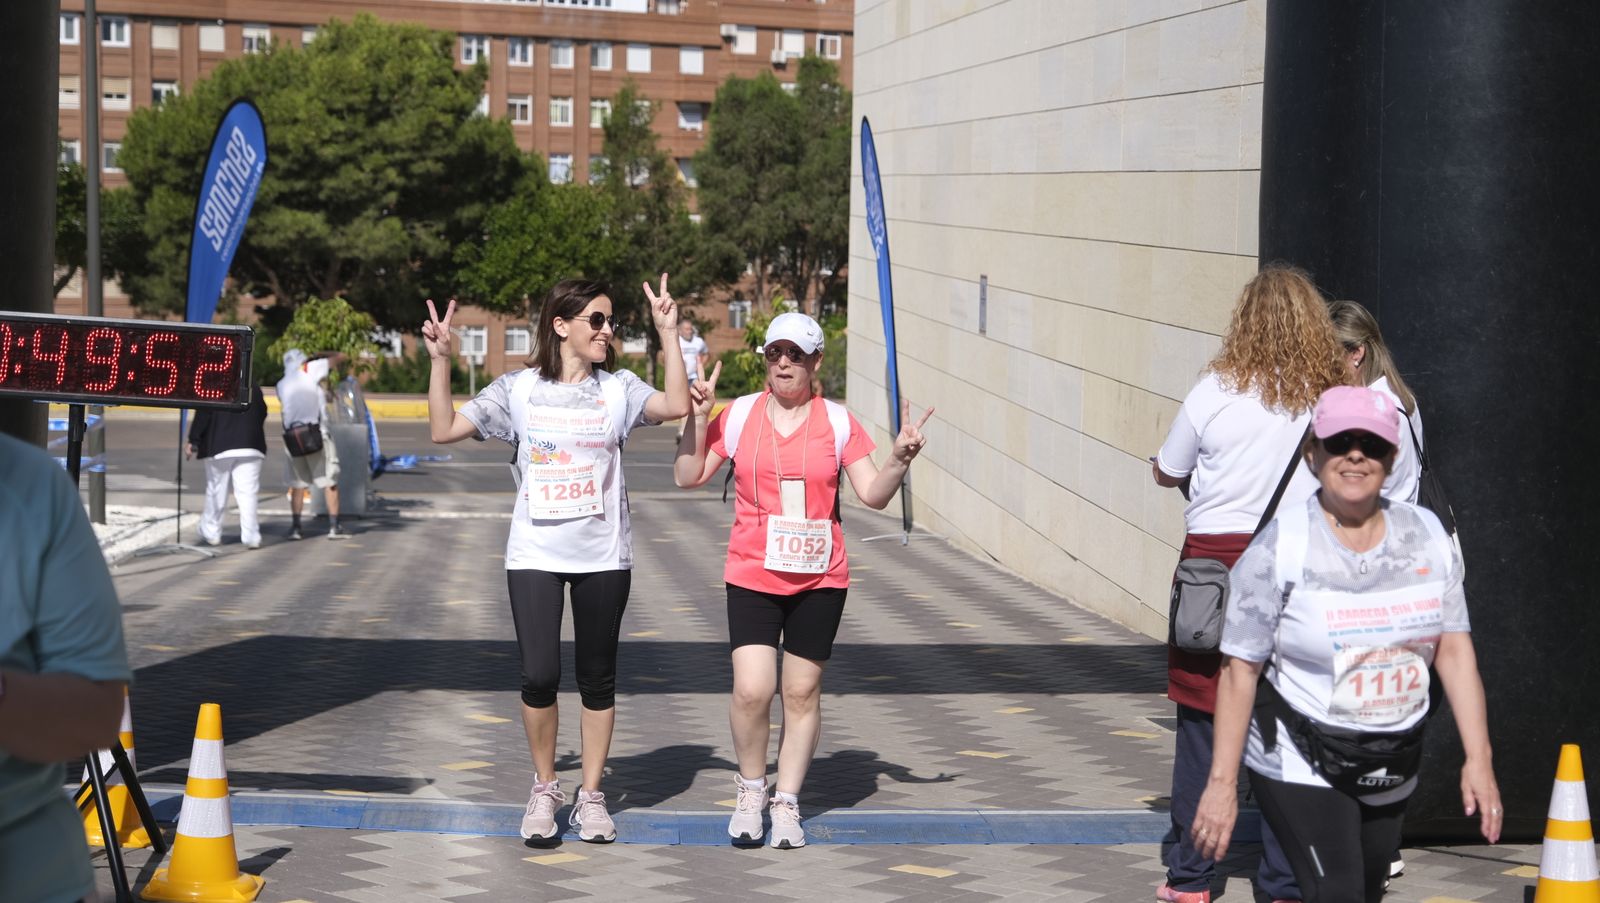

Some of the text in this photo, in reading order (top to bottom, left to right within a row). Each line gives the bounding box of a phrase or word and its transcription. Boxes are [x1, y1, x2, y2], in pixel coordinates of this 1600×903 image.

[583, 441, 606, 449] JUNIO
[540, 480, 596, 501] 1284
[775, 535, 827, 555] 1052
[1337, 606, 1390, 619] CARRERA
[1390, 603, 1413, 615] SIN
[1348, 665, 1422, 697] 1112
